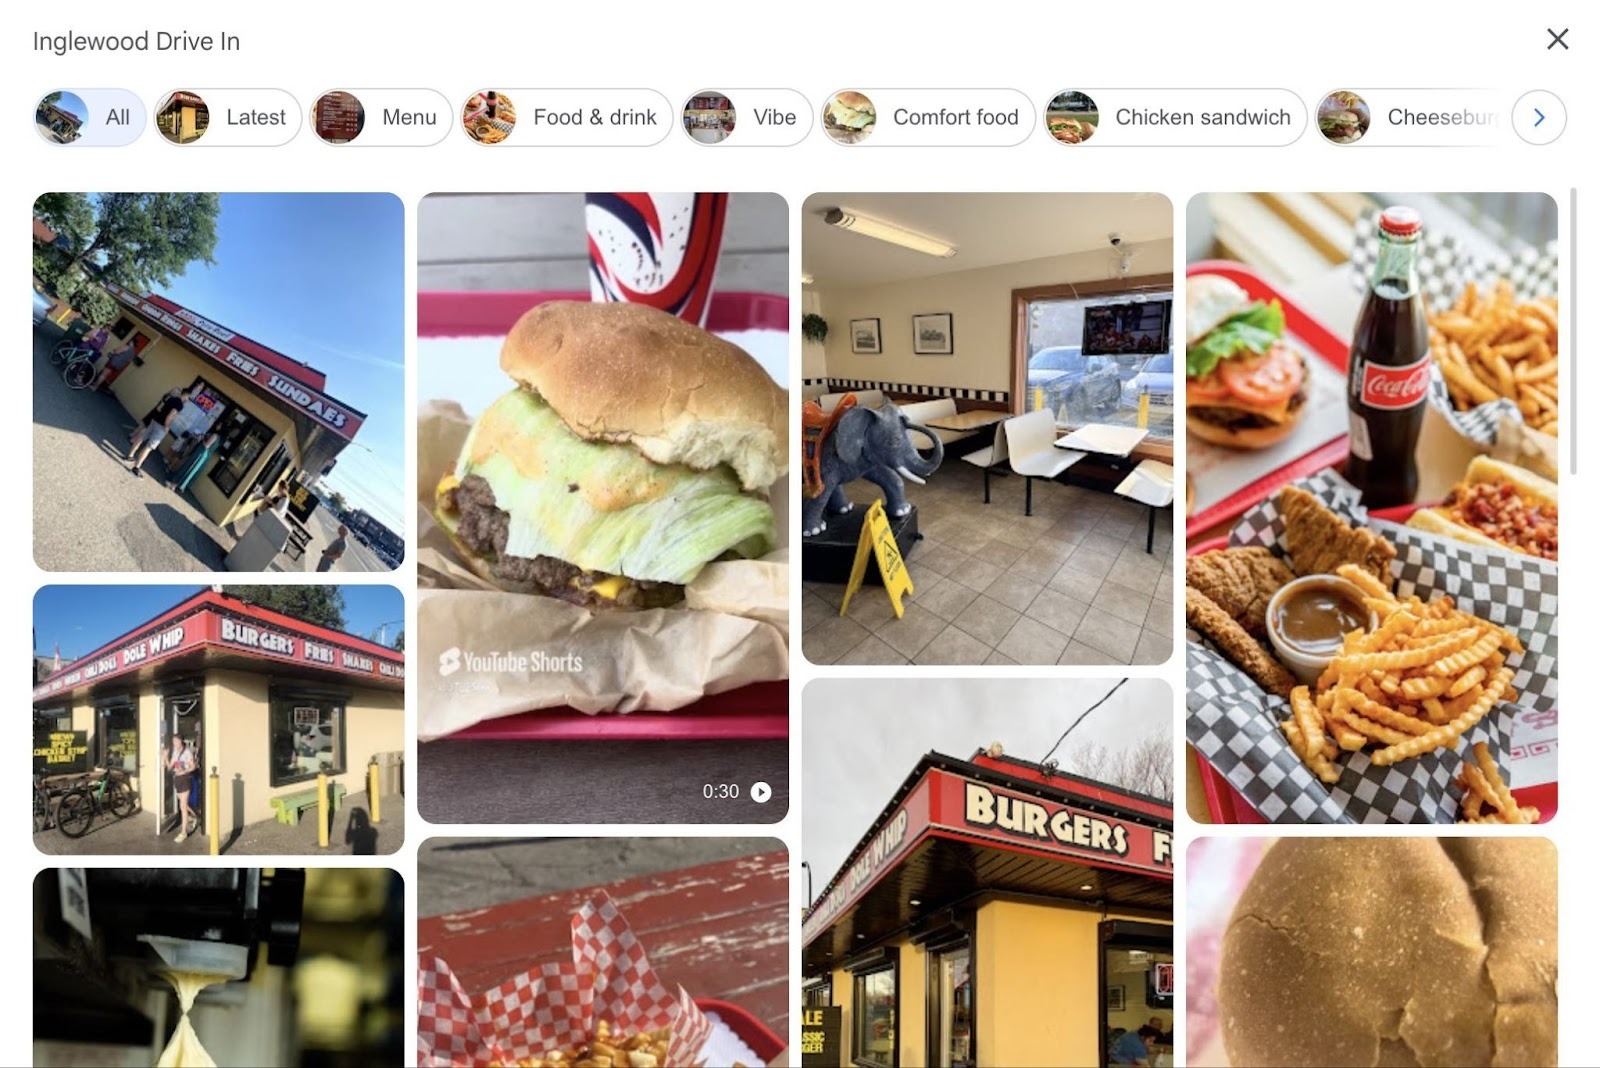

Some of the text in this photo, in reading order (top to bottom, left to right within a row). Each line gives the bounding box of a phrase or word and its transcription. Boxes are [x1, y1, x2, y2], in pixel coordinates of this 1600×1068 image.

[34, 30, 240, 57] Inglewood Drive In
[105, 108, 130, 126] All
[227, 108, 287, 126] Latest
[383, 108, 437, 126] Menu
[534, 108, 657, 126] Food & drink
[753, 108, 797, 126] Vibe
[893, 108, 1019, 126] Comfort food
[1116, 108, 1291, 126] Chicken sandwich
[186, 329, 221, 355] SHAKES
[226, 351, 261, 377] FRIES
[268, 374, 348, 429] SUNDAES
[122, 645, 147, 666] DOLE
[148, 627, 185, 655] WHIP
[221, 618, 295, 657] BURGERS
[304, 642, 335, 665] FRIES
[341, 651, 374, 673] SHAKES
[964, 781, 1173, 865] BURGERS F
[849, 853, 872, 895] DOLE
[873, 807, 908, 868] WHIP
